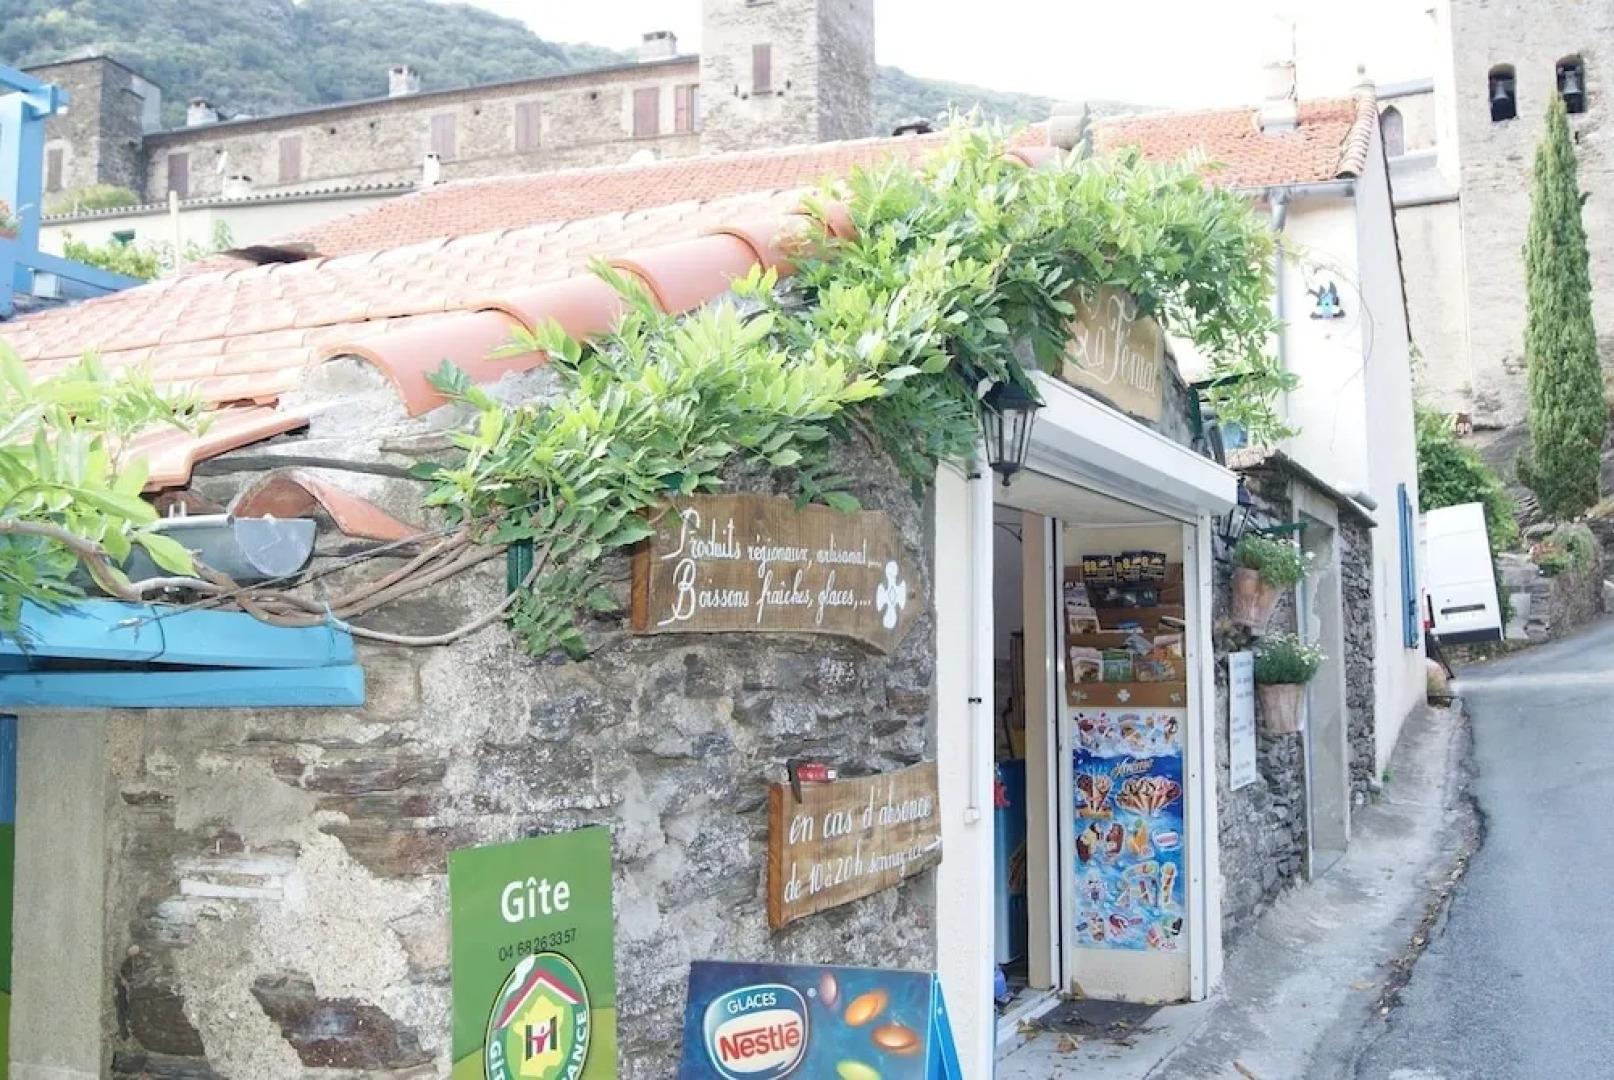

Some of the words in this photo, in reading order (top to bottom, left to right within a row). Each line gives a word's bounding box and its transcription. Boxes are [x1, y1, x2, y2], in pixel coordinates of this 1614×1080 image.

[660, 507, 741, 559] Produits
[657, 559, 750, 626] Boissons
[789, 814, 814, 845] en
[823, 810, 852, 838] cas
[863, 781, 932, 828] d'absence
[501, 876, 571, 923] Gîte
[784, 861, 802, 903] de
[809, 862, 823, 894] 10
[727, 992, 777, 1014] GLACES
[563, 1011, 586, 1080] ANCE
[719, 1021, 800, 1062] Nestlé
